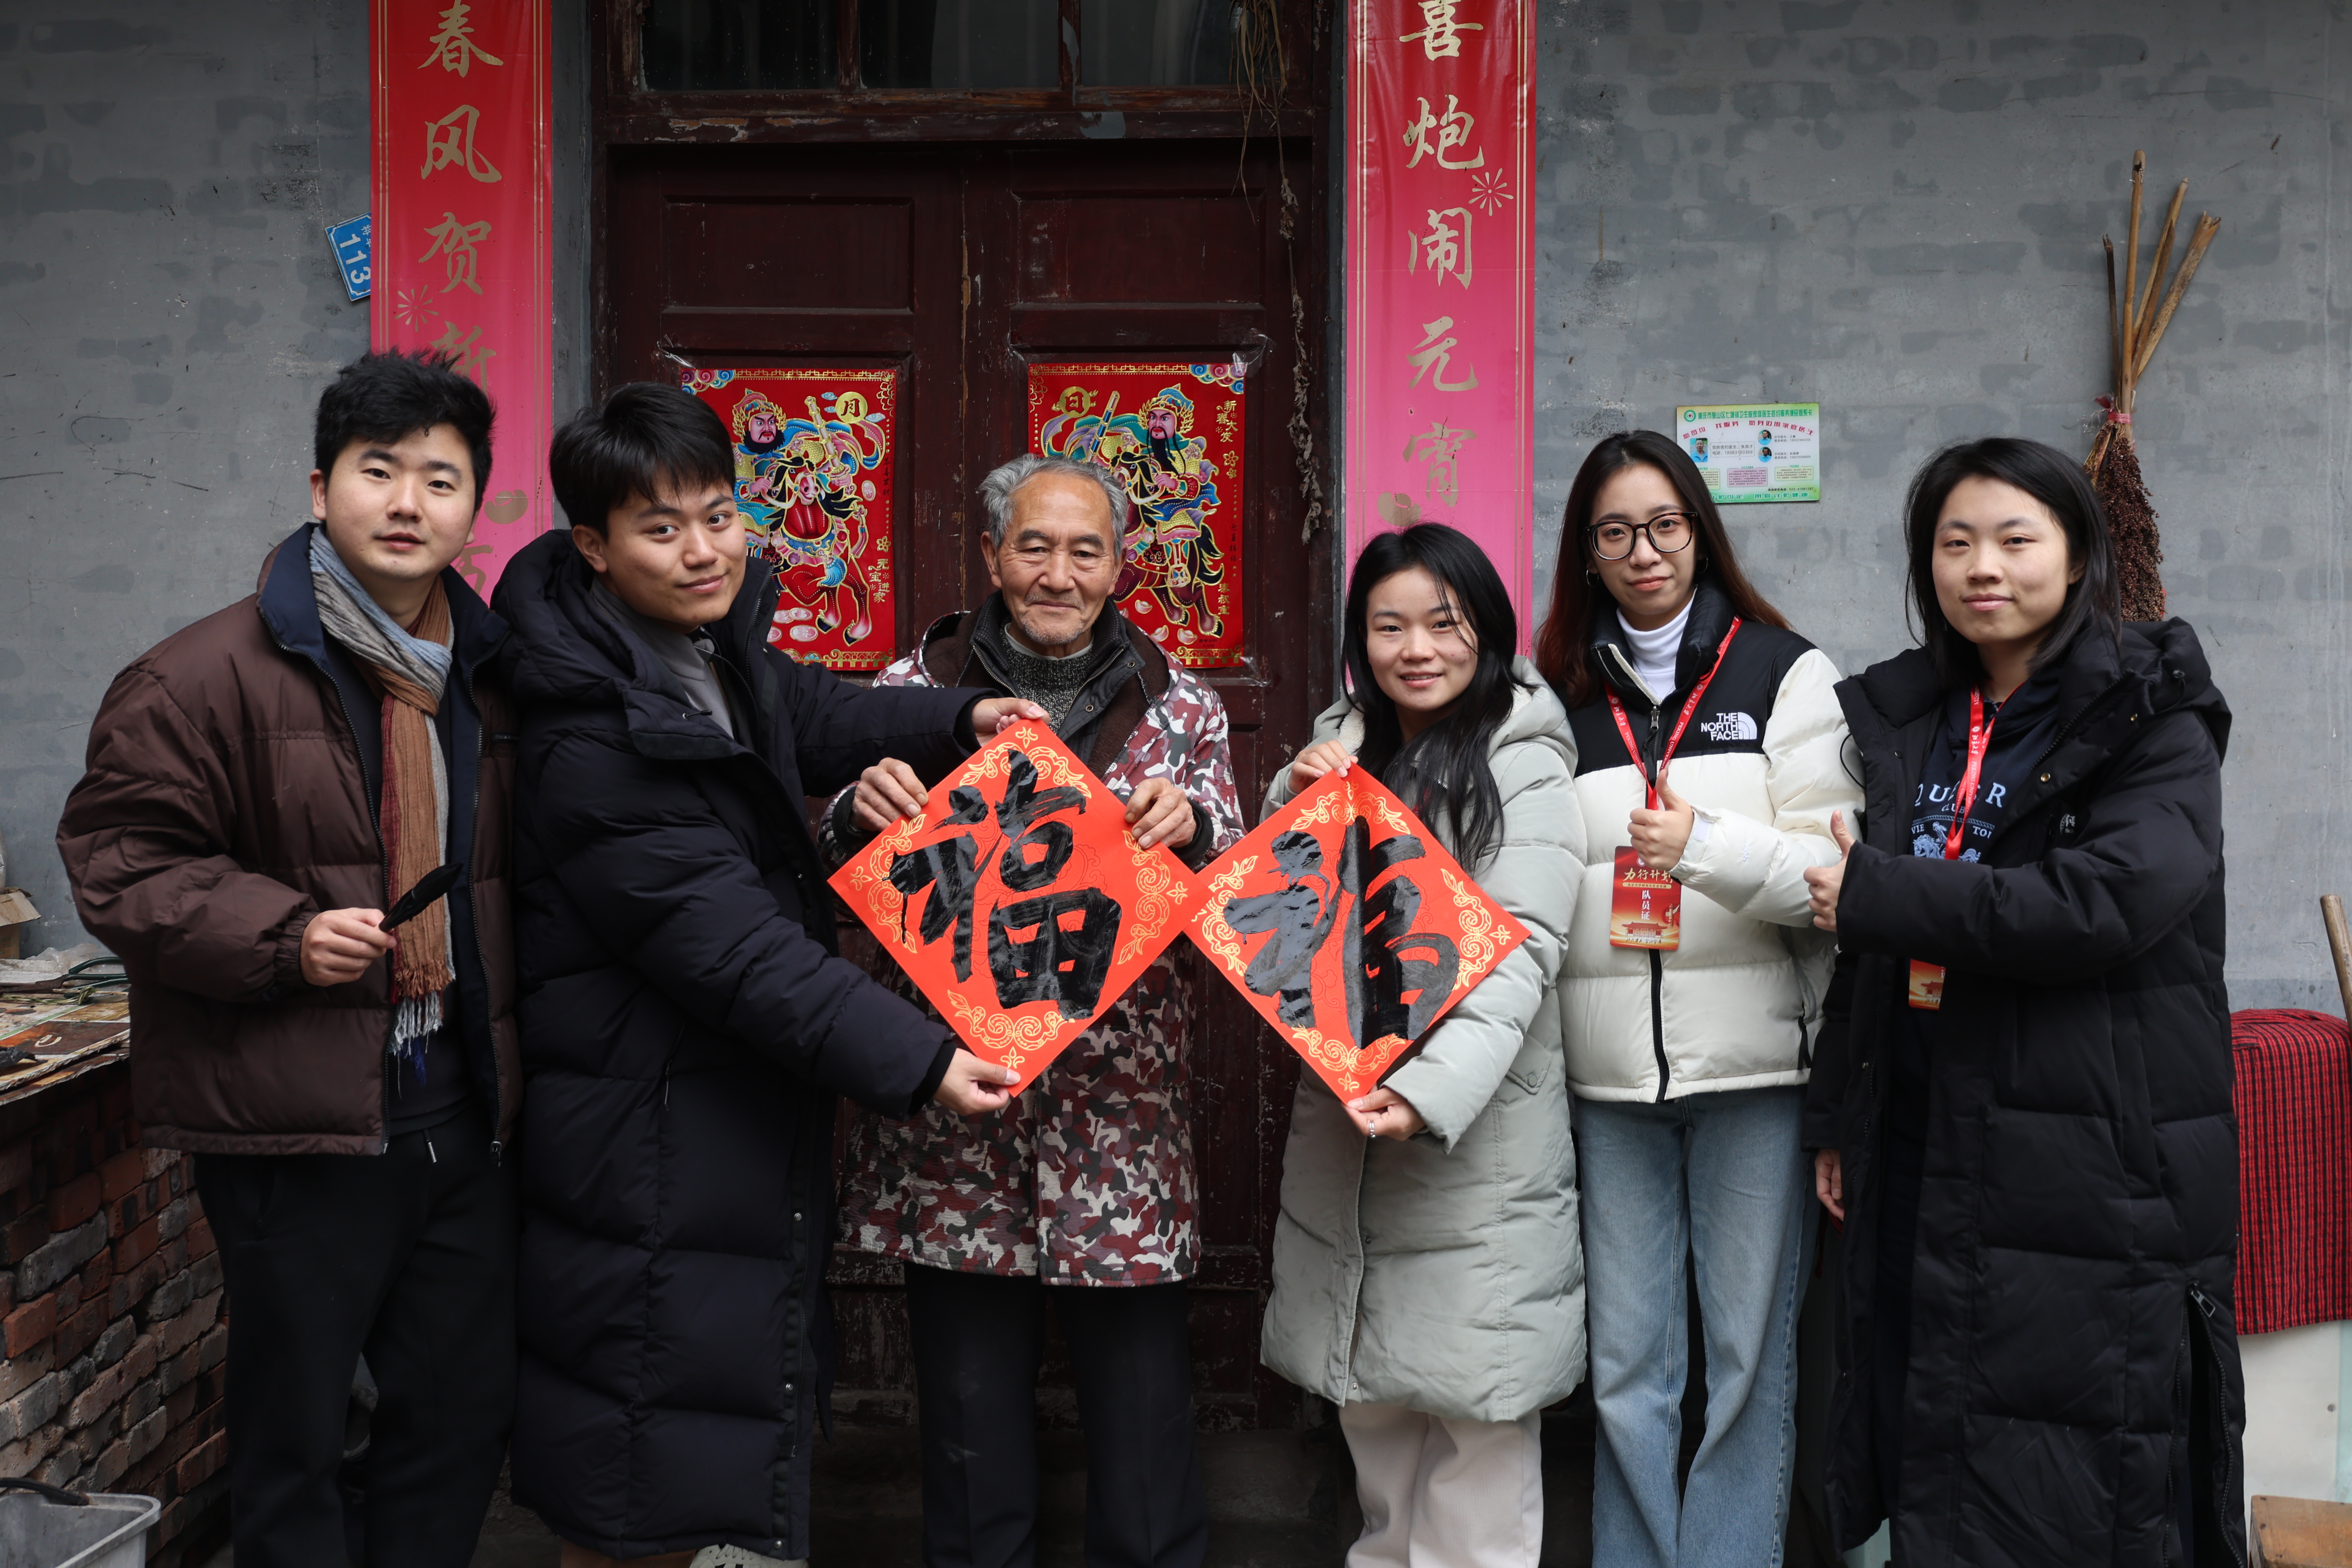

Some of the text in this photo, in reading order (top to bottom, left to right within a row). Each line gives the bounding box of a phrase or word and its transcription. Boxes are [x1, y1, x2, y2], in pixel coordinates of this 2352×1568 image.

[339, 233, 371, 284] 113
[841, 397, 860, 417] 月
[1065, 391, 1084, 414] 日
[1216, 400, 1238, 443] 新春大发
[1701, 722, 1738, 732] NORTH
[1716, 713, 1737, 722] THE
[1625, 731, 1634, 750] PEKING
[1672, 722, 1684, 741] PEKING
[1710, 731, 1738, 741] FACE
[882, 749, 1122, 1021] 福
[1623, 867, 1673, 884] 力行计划
[1641, 890, 1651, 920] 队员证
[1223, 815, 1459, 1049] 福
